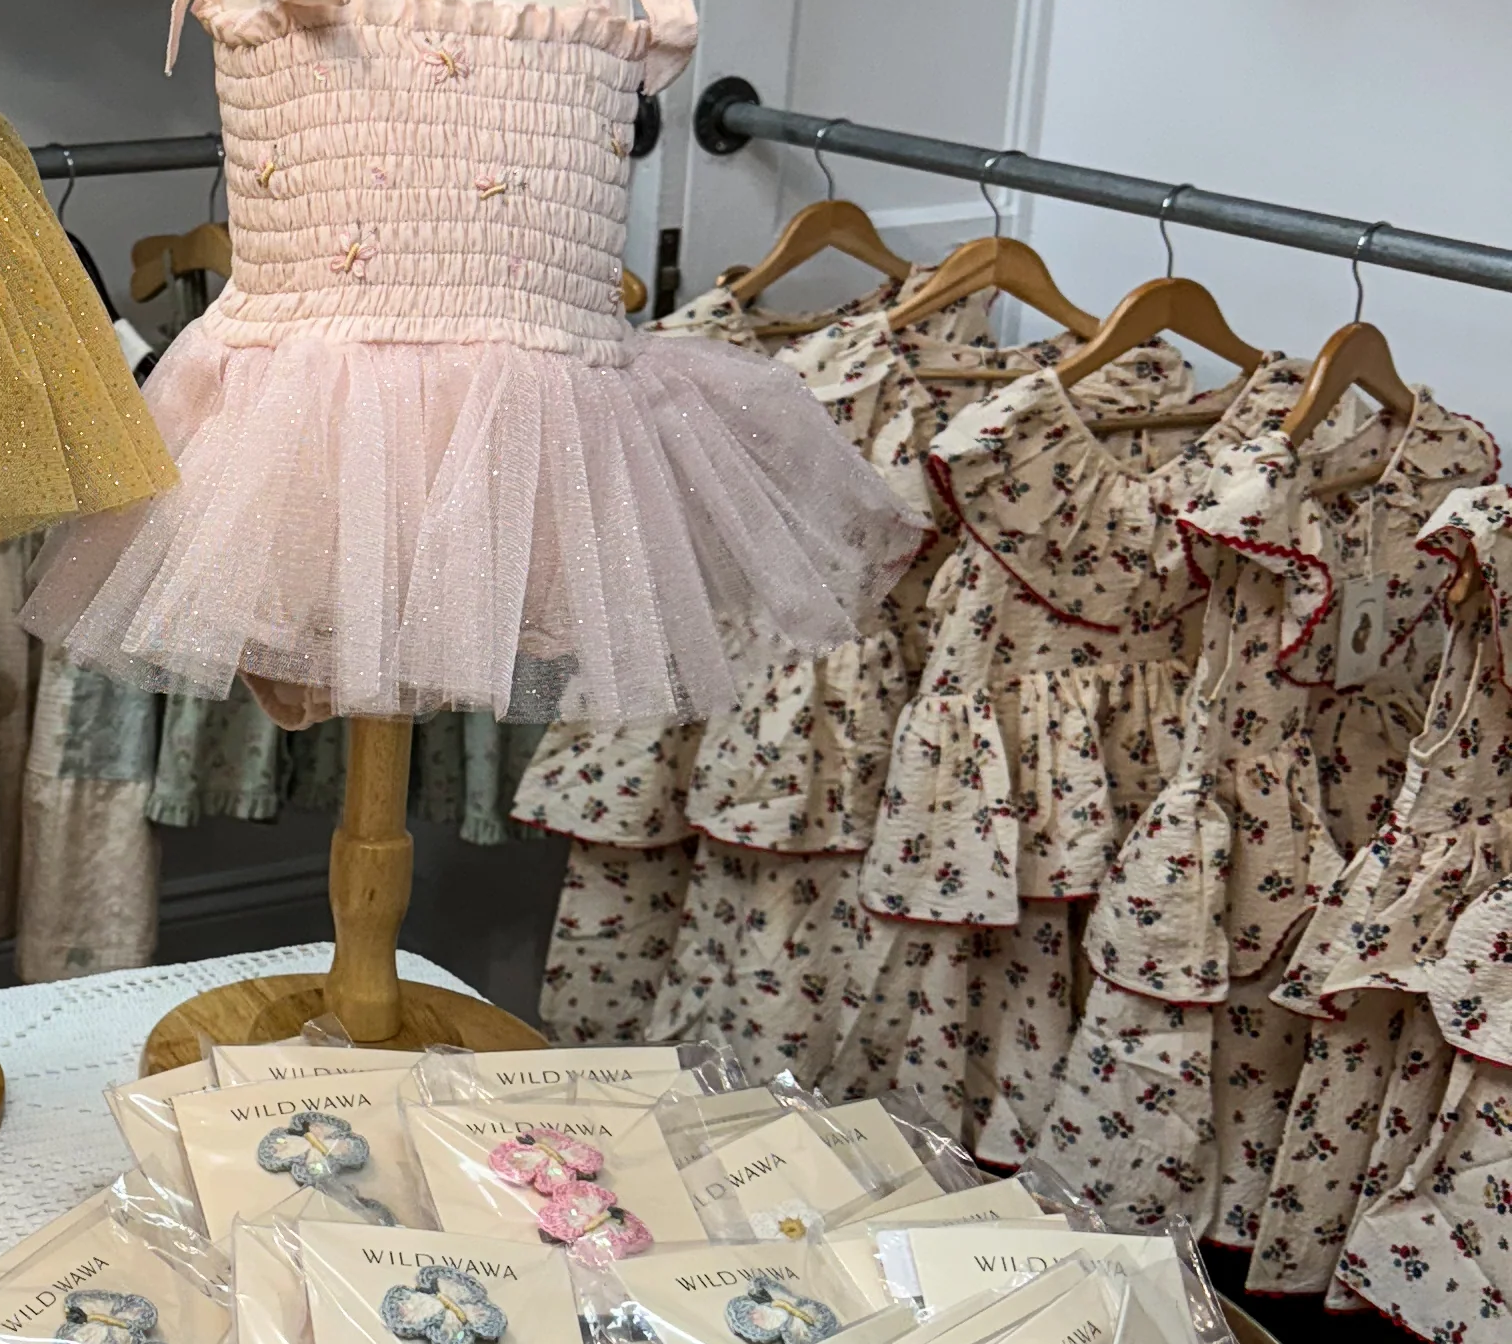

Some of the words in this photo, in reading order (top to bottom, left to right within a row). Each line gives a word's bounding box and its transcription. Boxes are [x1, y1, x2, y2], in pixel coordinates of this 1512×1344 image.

[496, 1069, 561, 1086] WILD
[565, 1069, 633, 1084] WAWA
[230, 1100, 297, 1123] WILD
[301, 1093, 372, 1113] WAWA
[465, 1121, 534, 1136] WILD
[724, 1152, 788, 1188] WAWA
[362, 1248, 435, 1268] WILD
[441, 1255, 519, 1282] WAWA
[0, 1290, 57, 1333] WILD
[52, 1256, 110, 1293] WAWA
[675, 1270, 738, 1292] WILD
